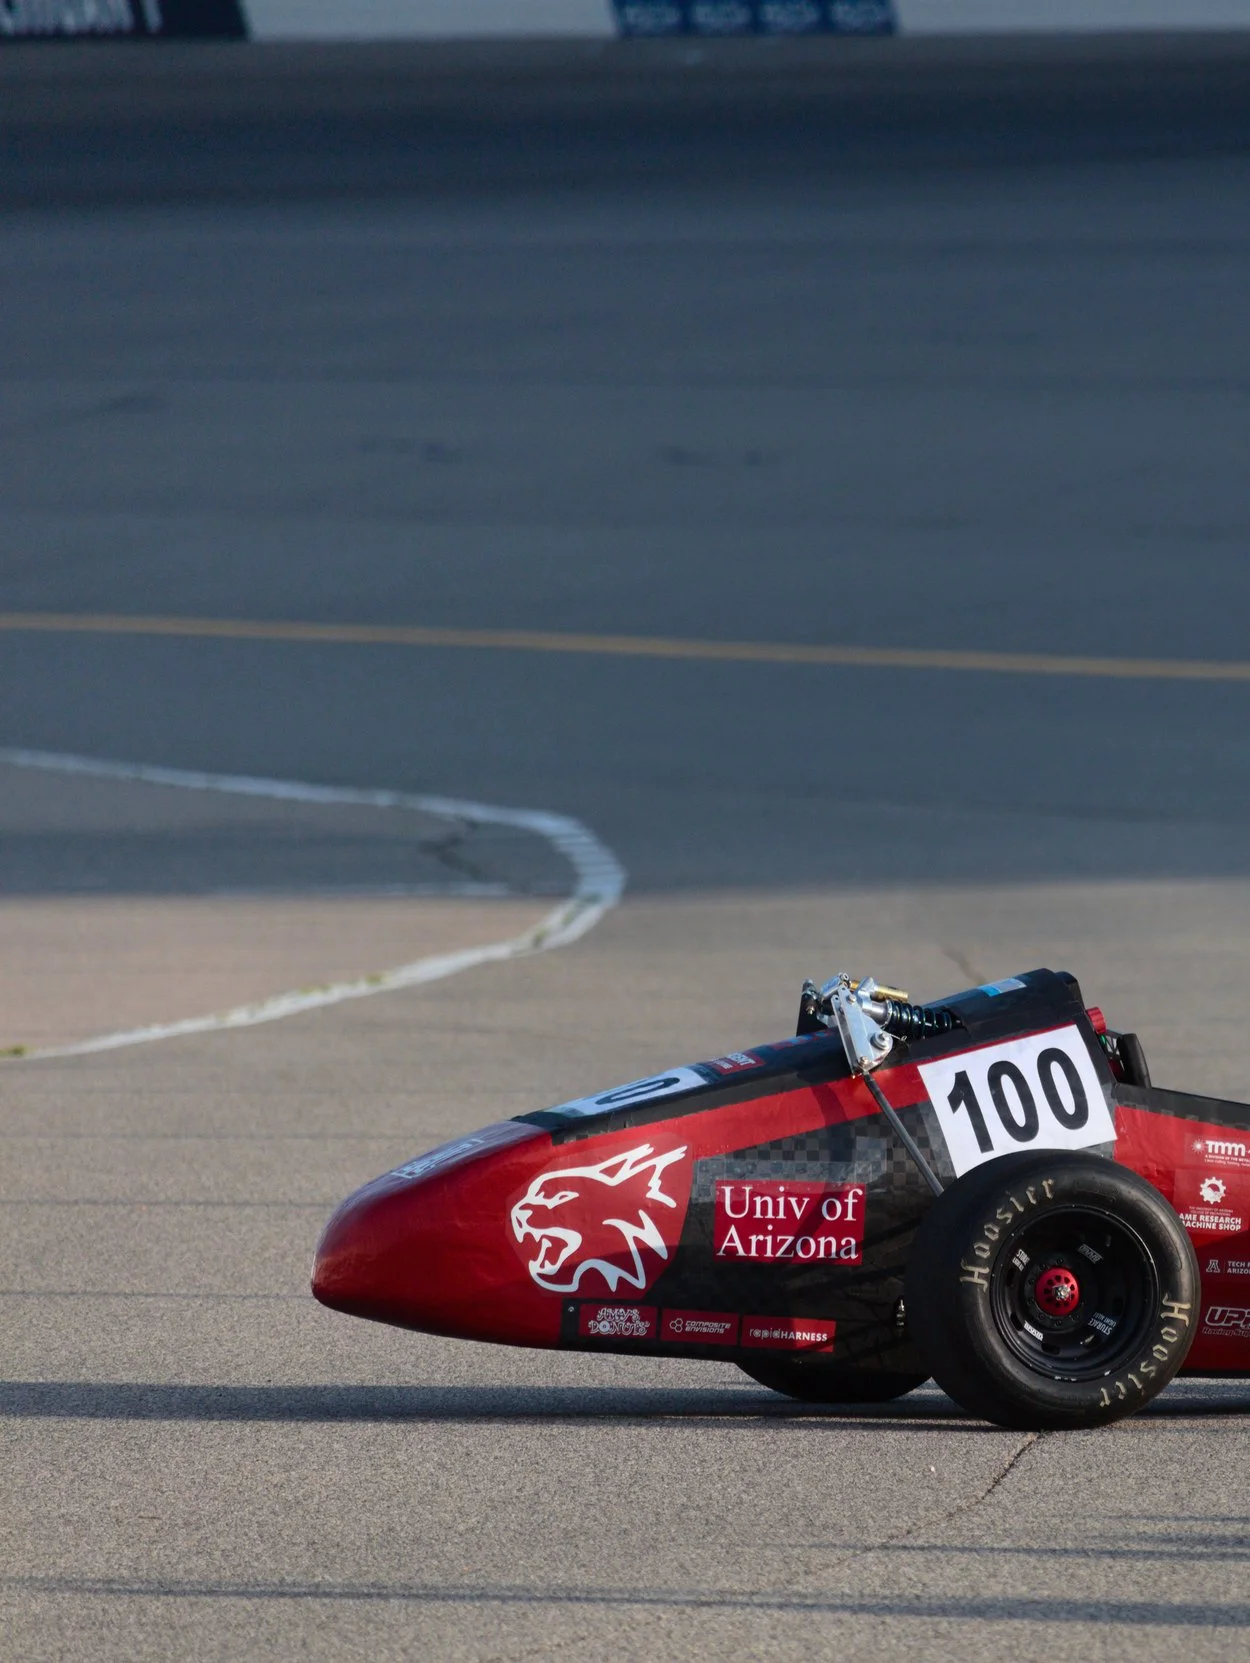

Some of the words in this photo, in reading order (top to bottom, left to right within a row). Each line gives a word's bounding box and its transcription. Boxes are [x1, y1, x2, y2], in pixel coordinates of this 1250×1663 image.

[947, 1047, 1090, 1154] 100
[720, 1185, 810, 1220] Univ
[821, 1188, 864, 1221] of
[1200, 1214, 1242, 1225] RESEARCH
[1218, 1222, 1242, 1232] SHOP
[716, 1223, 859, 1260] Arizona
[959, 1178, 1054, 1293] Hoosier
[1228, 1260, 1246, 1268] TECH
[597, 1307, 641, 1323] AMY'S
[588, 1320, 651, 1336] DONUTS
[685, 1320, 732, 1329] COMPOSITE
[685, 1326, 725, 1334] ENVISIONS
[749, 1327, 828, 1342] rapidHARNESS
[1100, 1293, 1192, 1408] Hoosier
